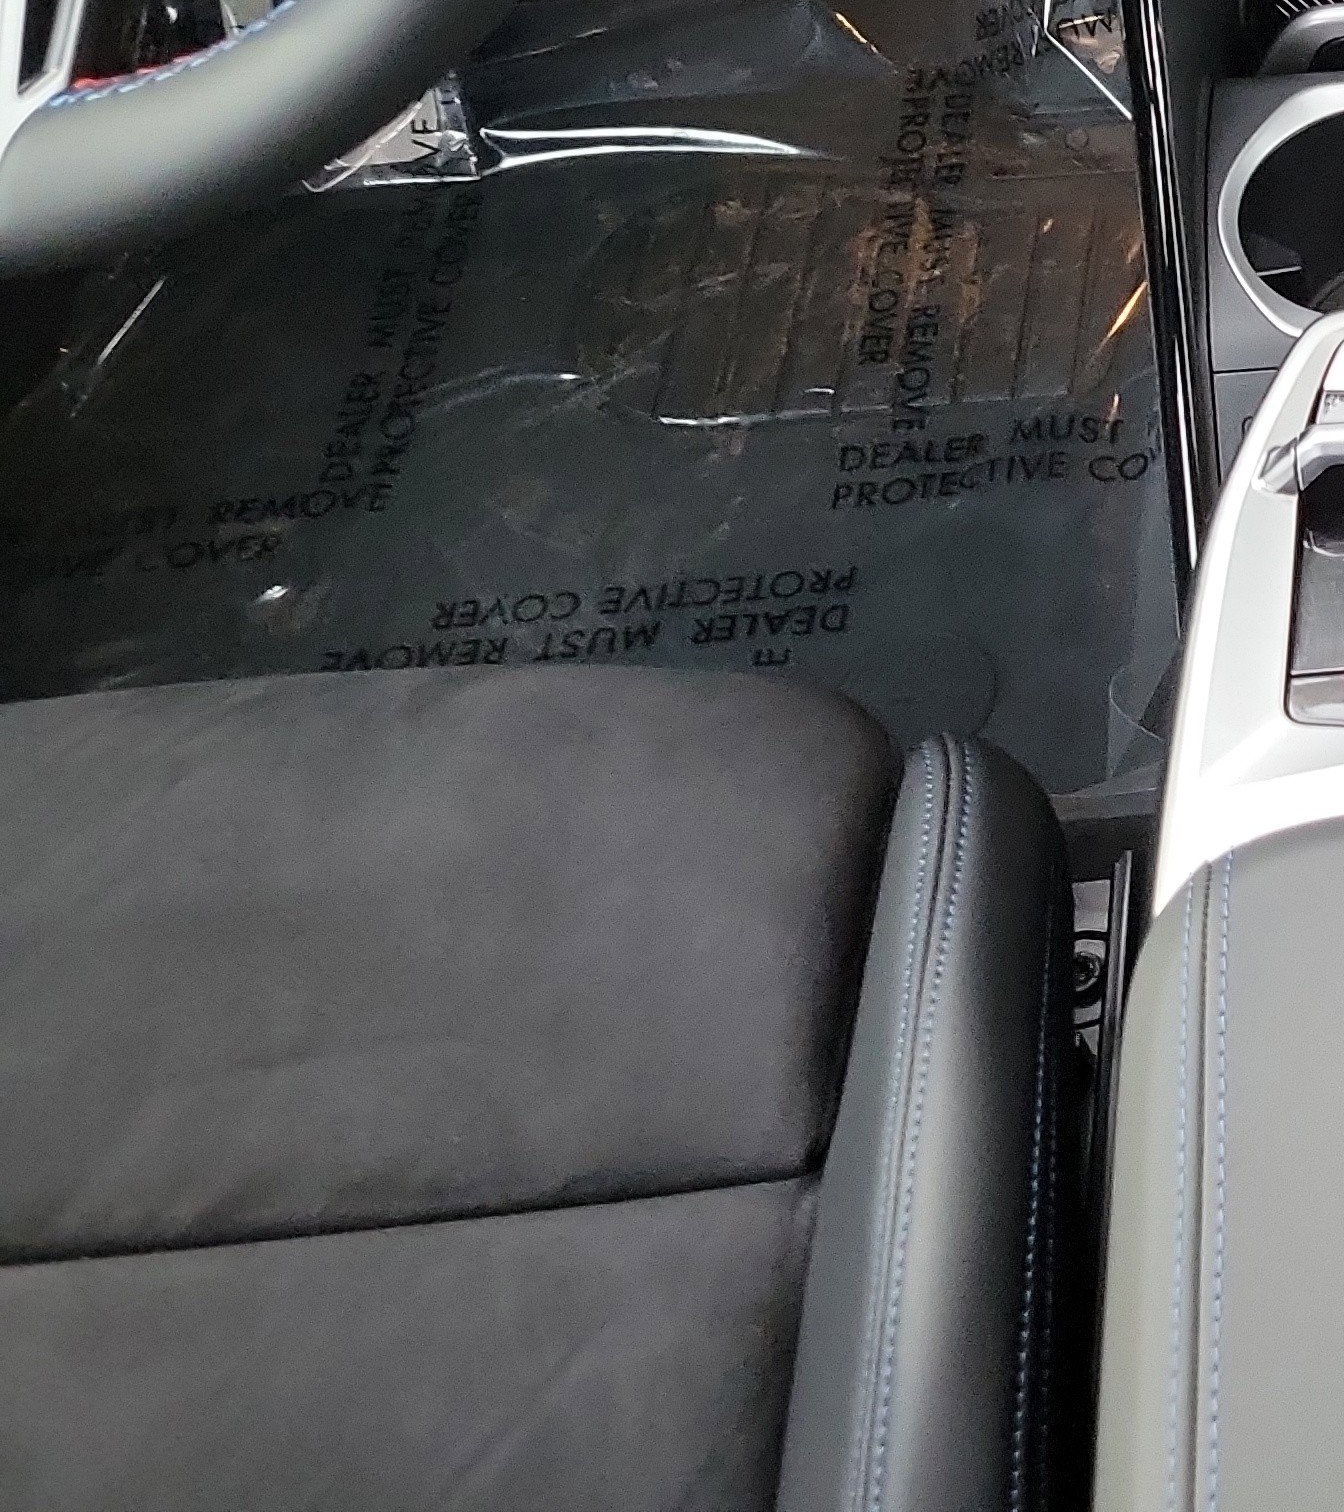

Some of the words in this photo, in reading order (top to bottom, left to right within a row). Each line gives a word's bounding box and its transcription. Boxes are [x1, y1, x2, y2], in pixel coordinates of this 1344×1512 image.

[839, 433, 988, 473] DEALER
[1009, 415, 1124, 446] MUST
[831, 450, 1071, 510] PROTECTIVE
[431, 590, 582, 631] COVER
[600, 564, 858, 617] PROTECTIVE
[531, 619, 663, 664] MUST
[691, 603, 850, 646] DEALER
